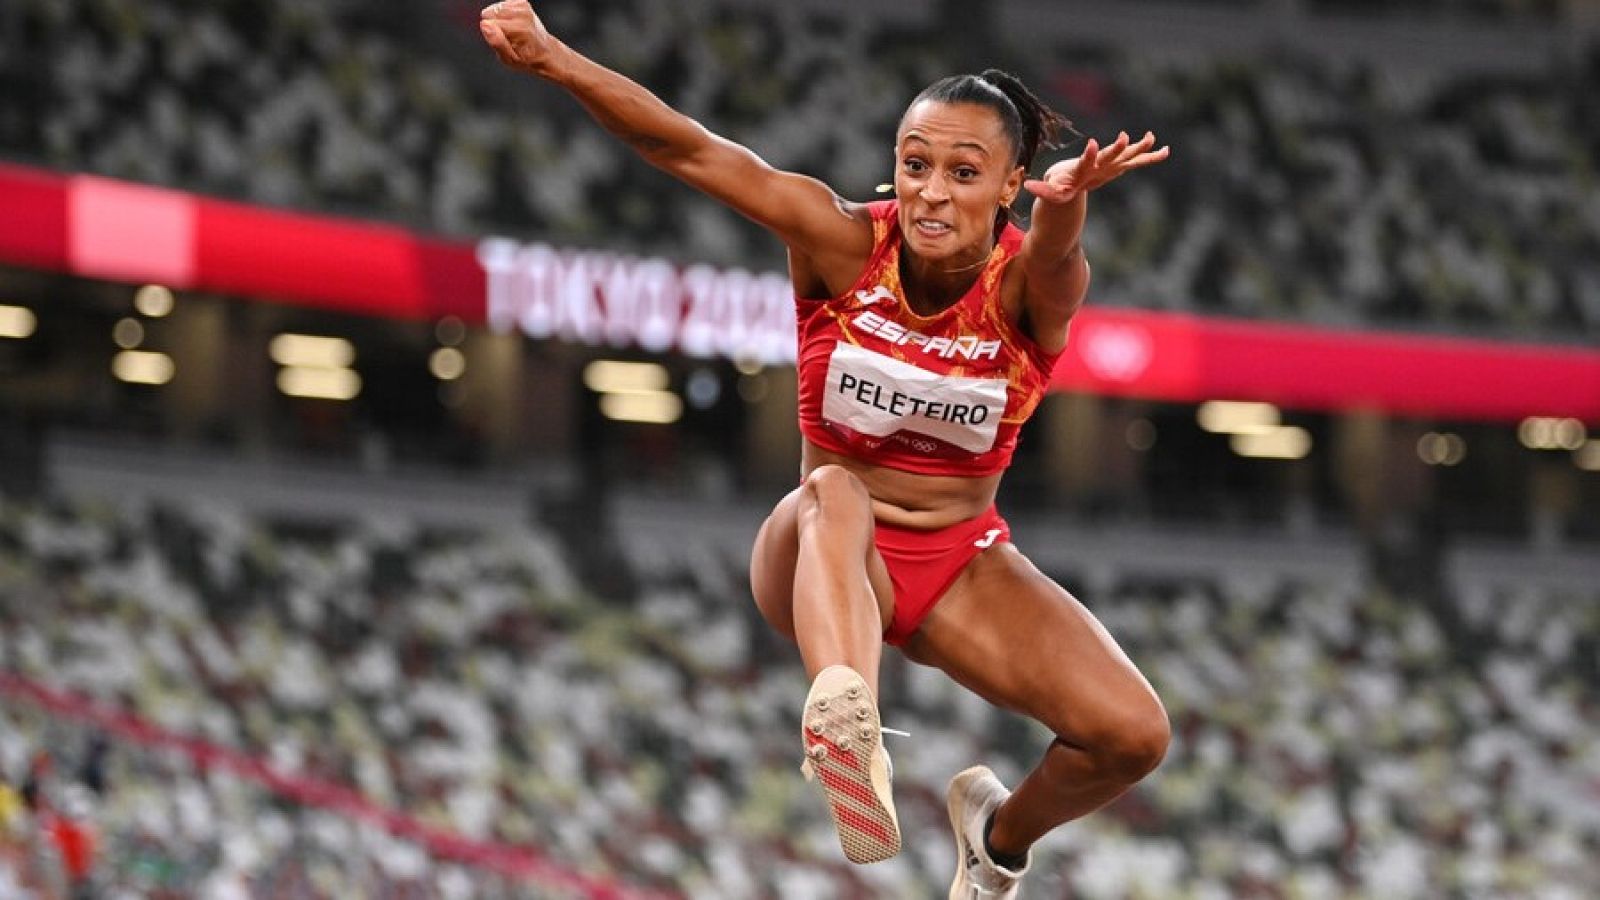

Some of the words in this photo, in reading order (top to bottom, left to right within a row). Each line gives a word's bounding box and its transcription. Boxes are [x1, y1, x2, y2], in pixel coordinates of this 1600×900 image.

[476, 237, 677, 352] TOKYO
[852, 311, 1001, 361] ESPAÑA
[839, 373, 988, 425] PELETEIRO
